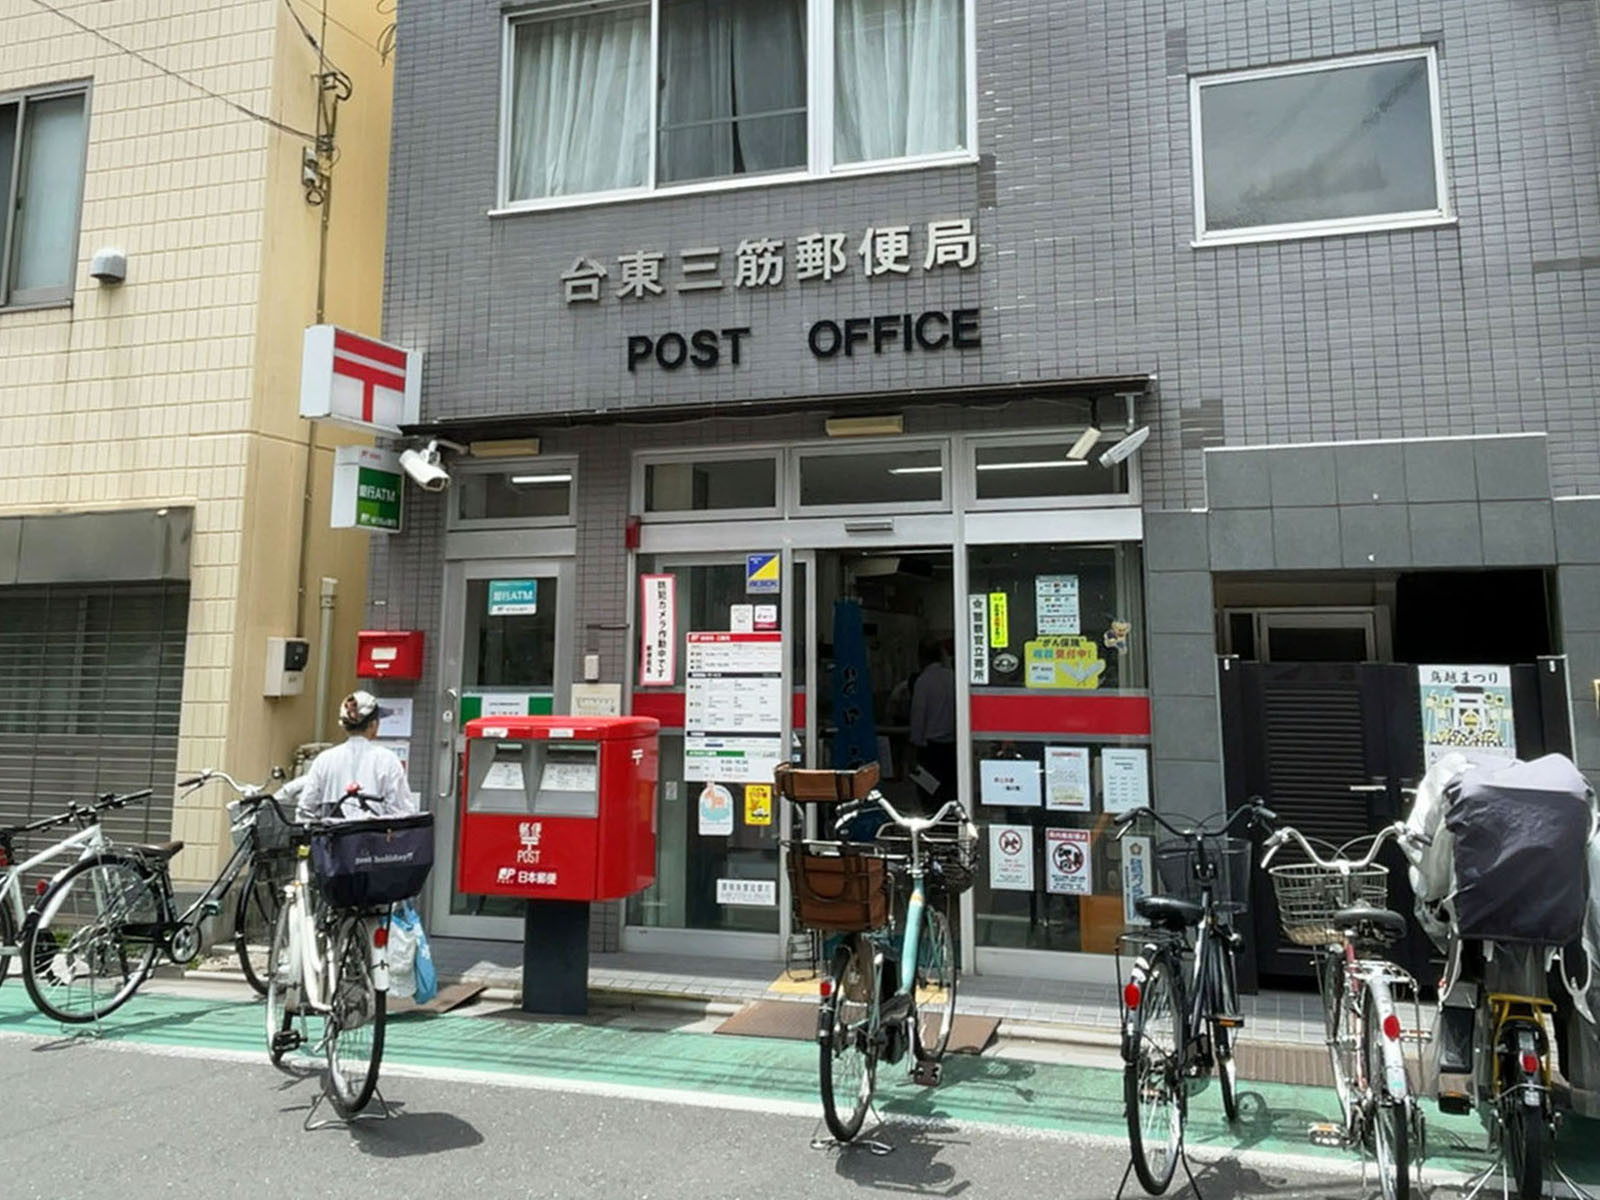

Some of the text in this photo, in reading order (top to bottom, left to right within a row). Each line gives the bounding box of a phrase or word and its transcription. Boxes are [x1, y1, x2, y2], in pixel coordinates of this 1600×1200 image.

[561, 218, 980, 304] 台東三筋郵便局
[627, 308, 982, 373] POST OFFICE
[1431, 670, 1499, 684] 鳥越まつり
[517, 850, 541, 864] POST
[517, 870, 558, 886] 日本郵便
